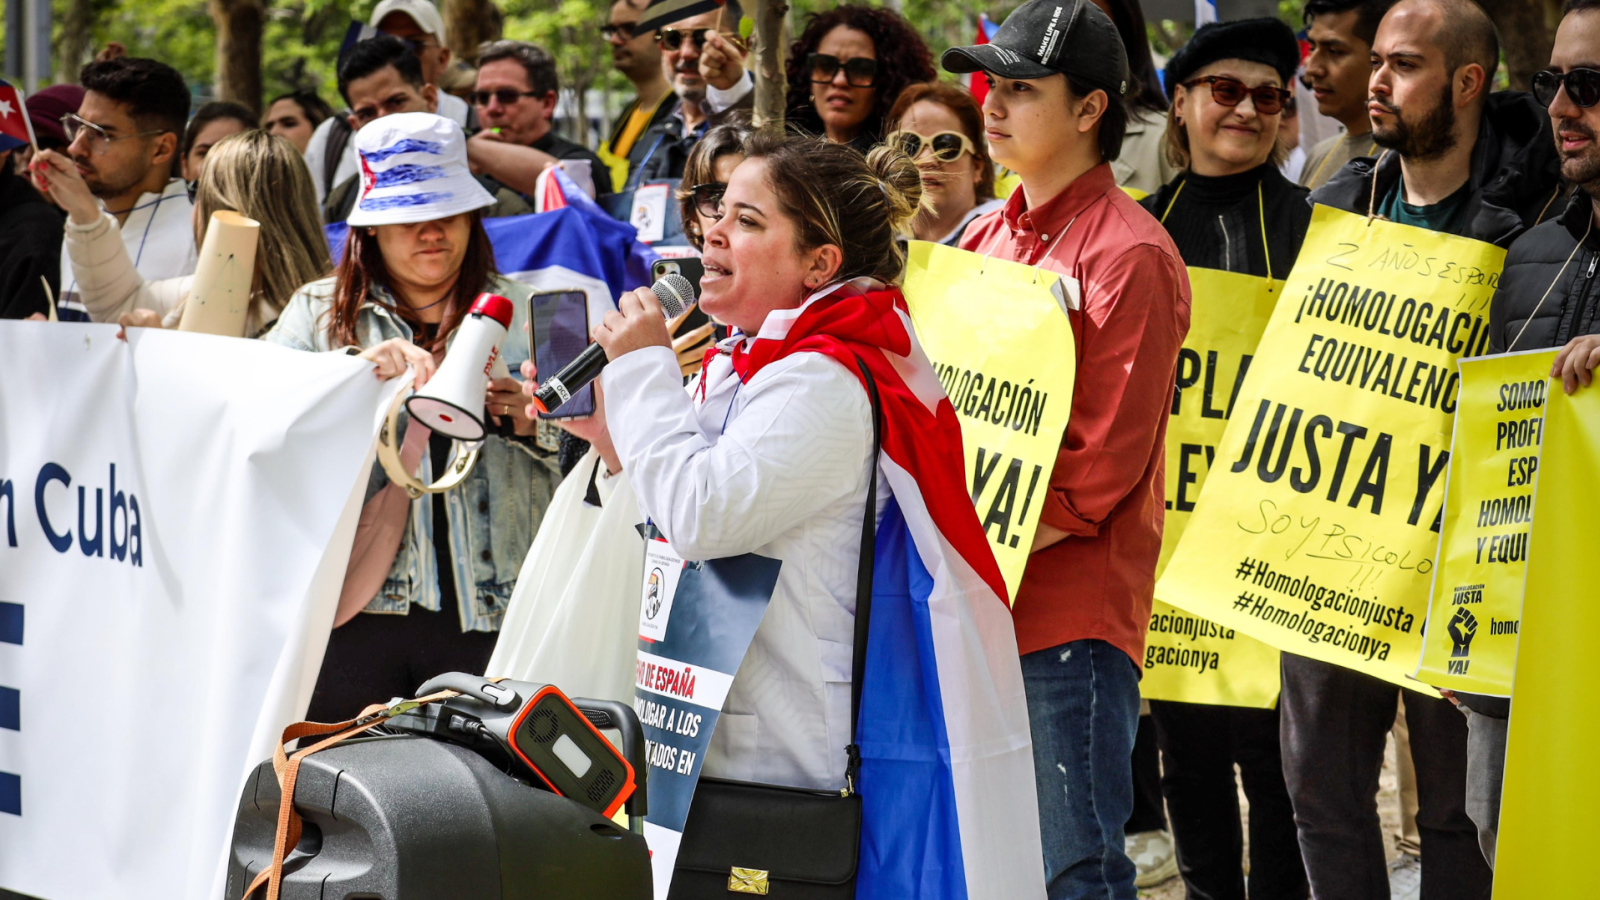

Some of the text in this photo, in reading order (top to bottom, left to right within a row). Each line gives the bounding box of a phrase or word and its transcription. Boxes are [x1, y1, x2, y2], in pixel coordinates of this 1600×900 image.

[1037, 36, 1050, 57] MAKE
[1497, 379, 1547, 412] SOMO
[1230, 399, 1393, 516] JUSTA
[35, 461, 143, 567] Cuba
[971, 447, 1043, 549] YA!
[1237, 499, 1320, 561] SOY
[1476, 537, 1487, 564] Y
[1235, 556, 1414, 634] #Homologacionjusta
[1452, 590, 1482, 605] JUSTA
[1232, 591, 1391, 662] #Homologacionya
[1144, 643, 1219, 674] gacionya
[1447, 660, 1470, 675] YA!
[645, 663, 656, 688] DE
[655, 666, 696, 699] ESPAÑA
[666, 708, 675, 732] A
[676, 710, 701, 738] LOS
[676, 749, 696, 776] EN
